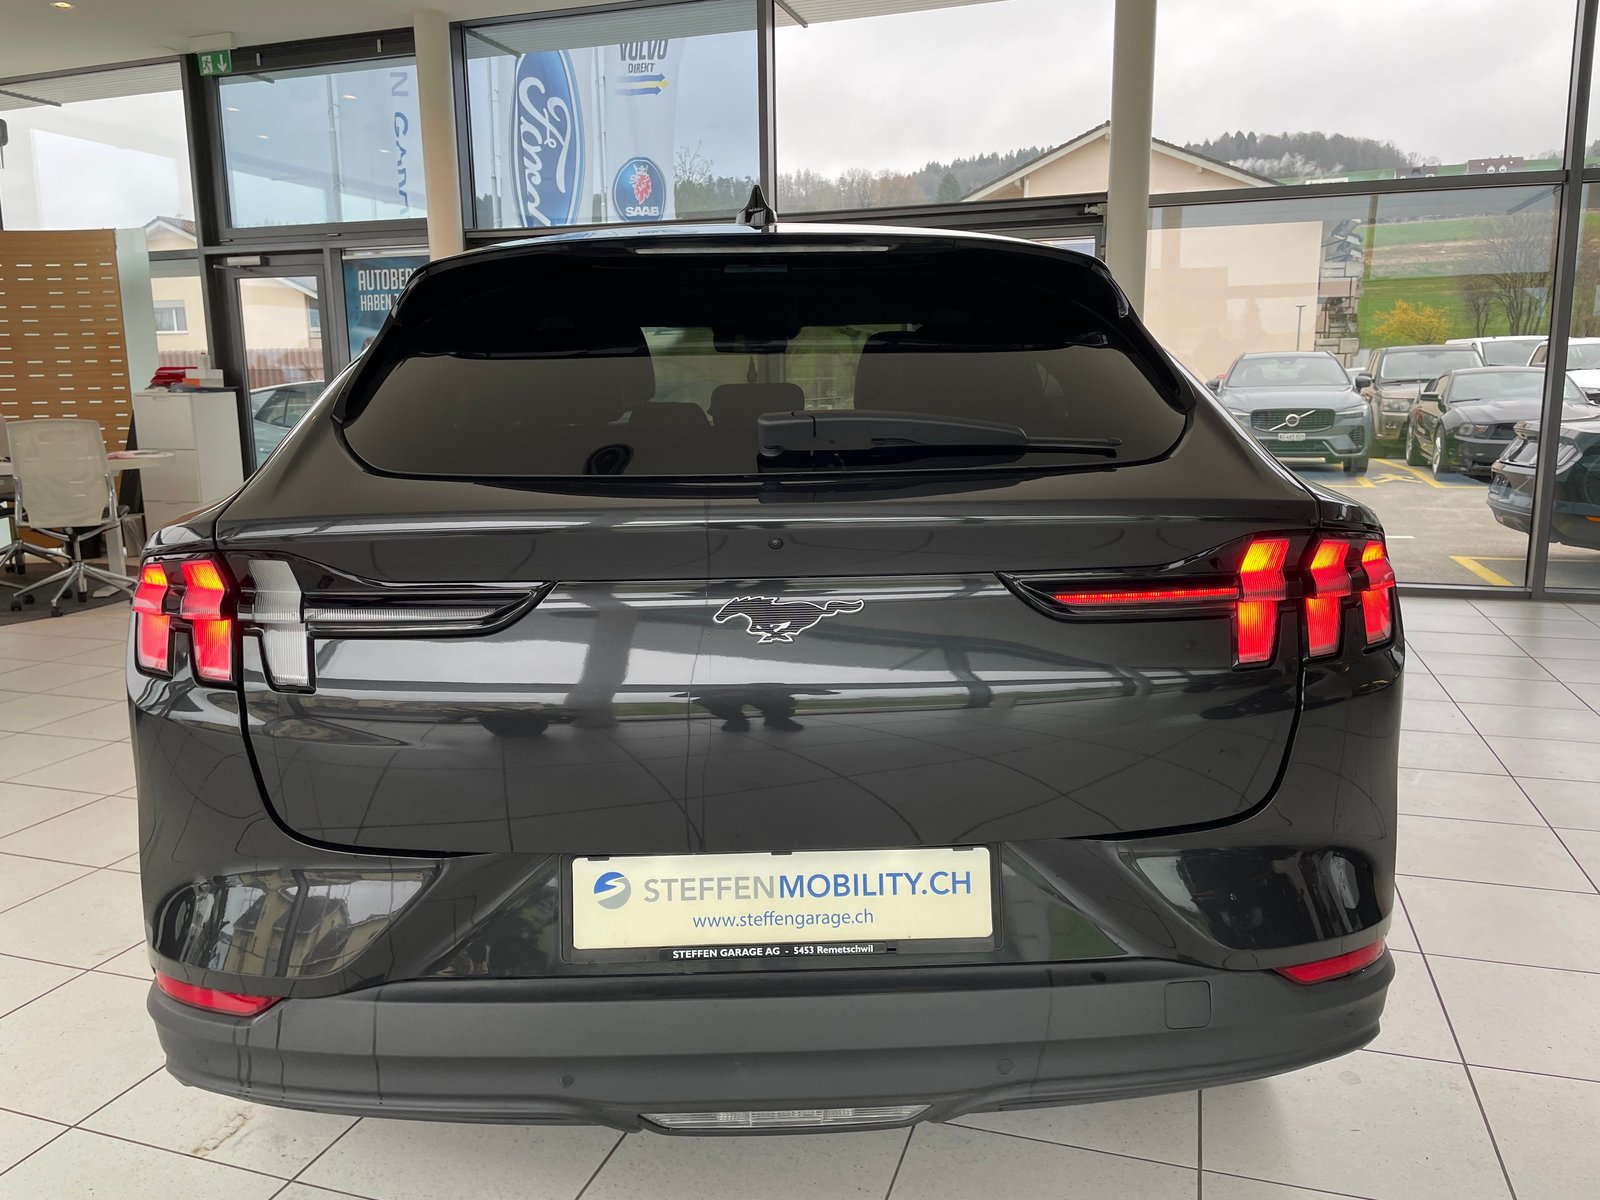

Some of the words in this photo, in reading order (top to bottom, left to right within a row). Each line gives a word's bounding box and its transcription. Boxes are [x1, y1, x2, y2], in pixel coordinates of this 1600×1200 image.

[619, 40, 669, 61] VOLVO
[628, 62, 656, 74] DIREKT
[518, 76, 572, 227] Ford
[625, 205, 660, 217] SAAB
[360, 293, 392, 311] HABEN
[643, 871, 971, 903] STEFFENMOBILITY.CH
[692, 908, 874, 929] www.steffengarage.ch
[672, 950, 718, 959] STEFFEN
[719, 947, 763, 957] GARAGE
[765, 947, 780, 956] AG
[793, 946, 815, 955] 5453
[817, 944, 874, 954] Remetschwil
